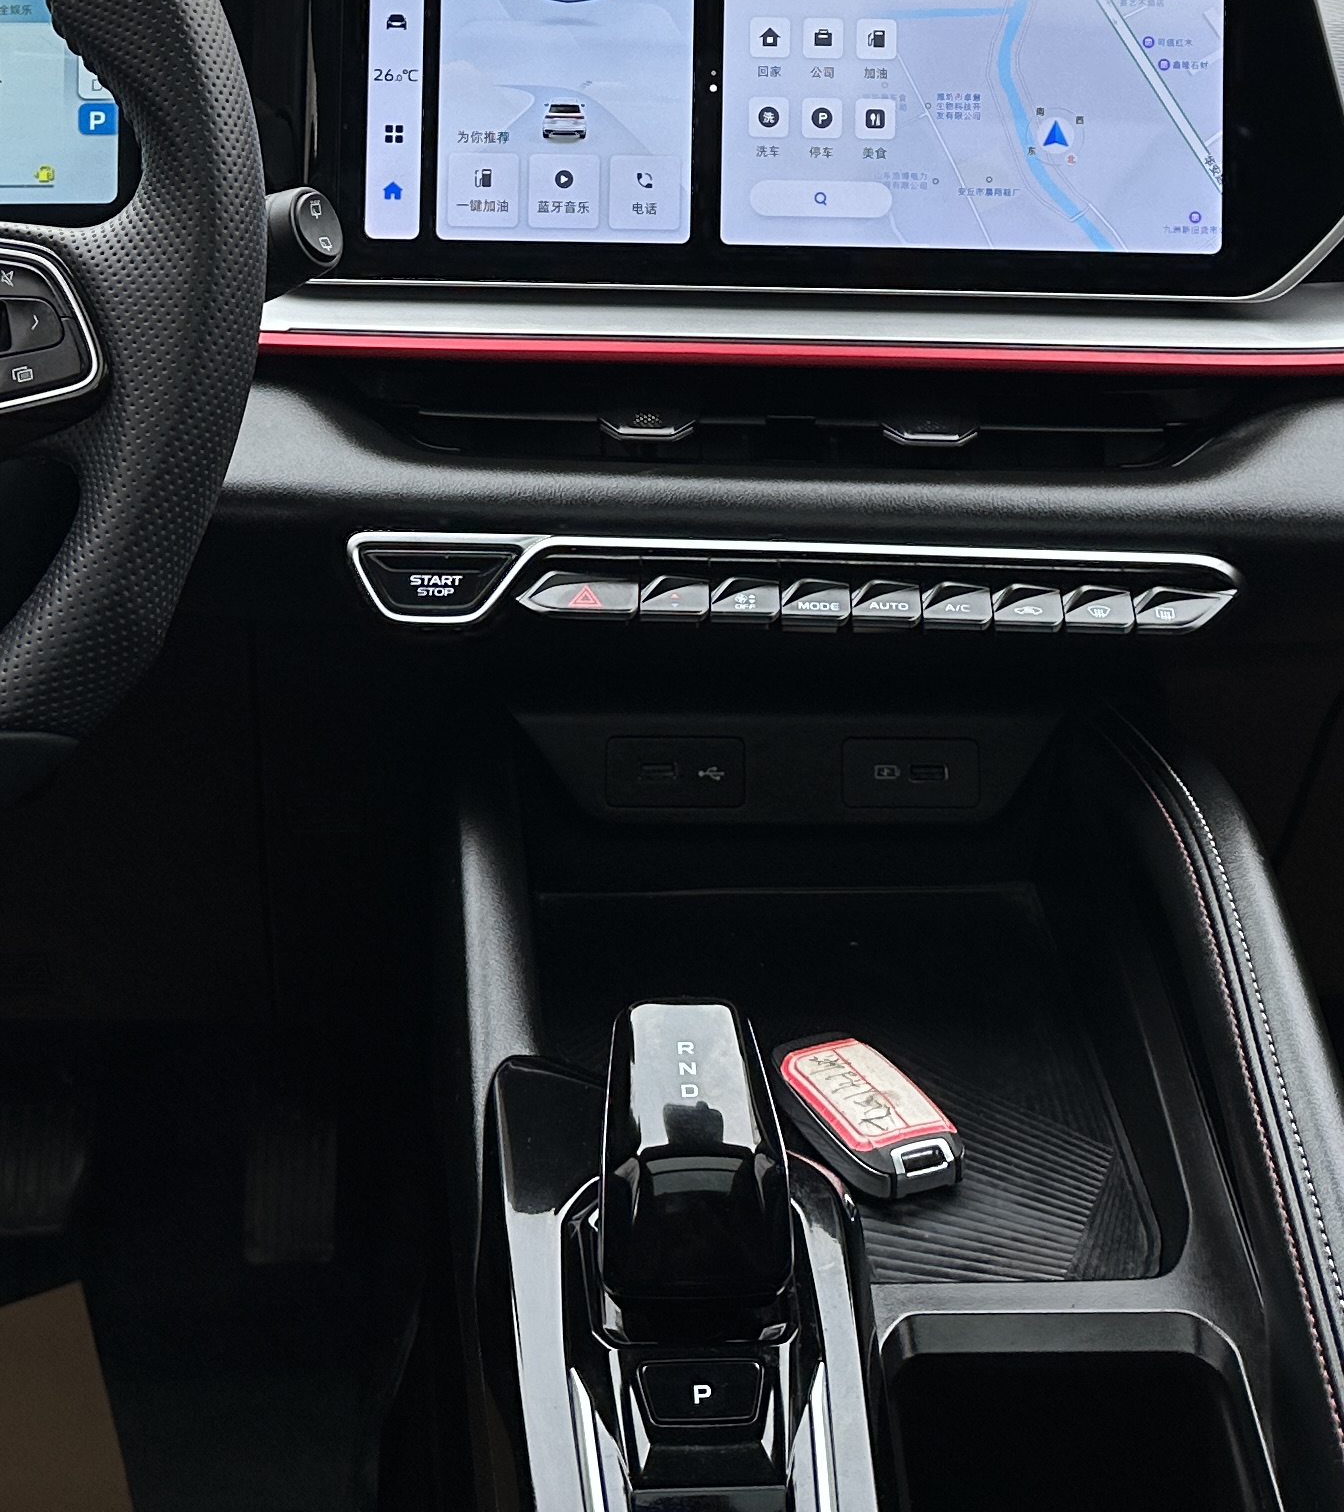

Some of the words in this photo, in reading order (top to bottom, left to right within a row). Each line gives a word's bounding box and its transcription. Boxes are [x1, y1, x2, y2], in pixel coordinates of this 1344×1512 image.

[757, 66, 782, 78] 回家
[810, 67, 835, 79] 公司
[863, 68, 888, 80] 加油
[89, 113, 105, 130] P
[457, 131, 510, 145] 为你推荐
[756, 145, 781, 158] 洗车
[809, 146, 834, 159] 停车
[862, 146, 887, 160] 美食
[456, 200, 509, 213] 一键加油
[537, 200, 590, 214] 蓝牙音乐
[632, 202, 657, 215] 电话
[409, 574, 463, 586] START
[417, 587, 454, 597] STOP
[797, 601, 840, 611] MODE
[869, 601, 909, 611] AUTO
[944, 603, 971, 613] A/C
[677, 1041, 695, 1055] R
[678, 1062, 697, 1076] N
[681, 1083, 699, 1098] D
[693, 1384, 712, 1404] P
